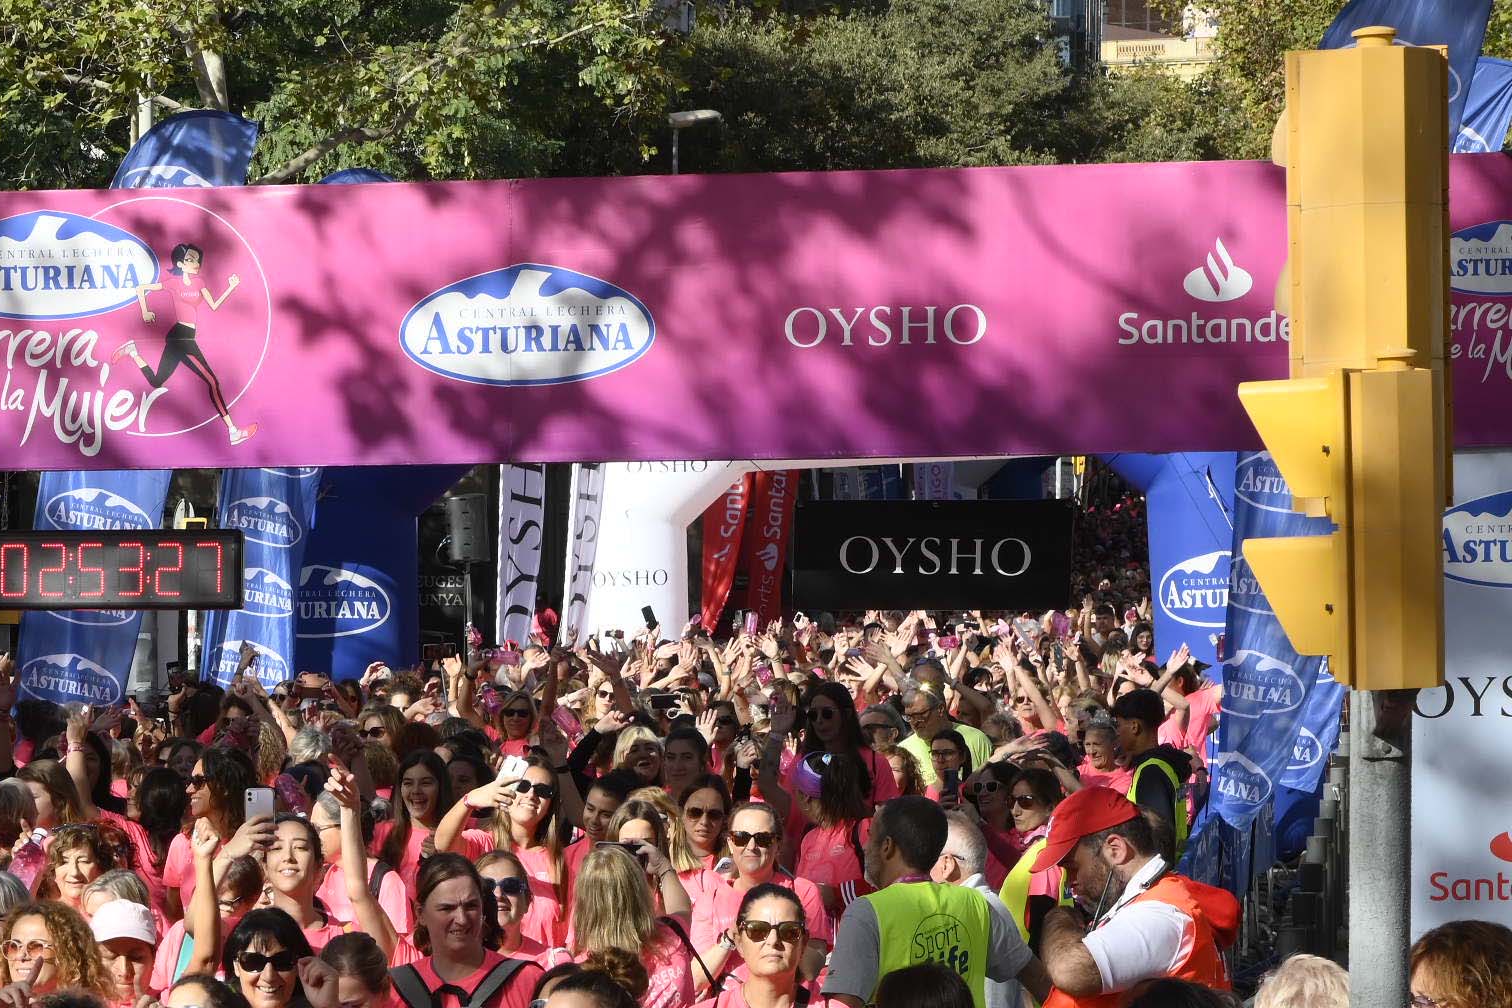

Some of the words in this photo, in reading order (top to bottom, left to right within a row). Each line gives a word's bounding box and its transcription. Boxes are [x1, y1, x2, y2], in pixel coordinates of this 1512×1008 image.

[62, 247, 138, 259] LECHERA
[460, 305, 539, 319] CENTRAL
[545, 304, 626, 318] LECHERA
[784, 303, 988, 348] OYSHO
[1118, 309, 1290, 345] Santande
[421, 310, 634, 356] ASTURIANA
[1468, 331, 1486, 359] la
[0, 372, 25, 411] la
[19, 362, 169, 457] Mujer
[0, 543, 221, 597] 02:53:27
[839, 535, 1032, 577] OYSHO
[592, 568, 668, 588] OYSHO
[1182, 577, 1230, 586] CENTRAL
[244, 589, 293, 611] URIANA
[297, 600, 381, 620] URIANA
[26, 666, 112, 701] ASTURIANA
[914, 920, 961, 959] Sport
